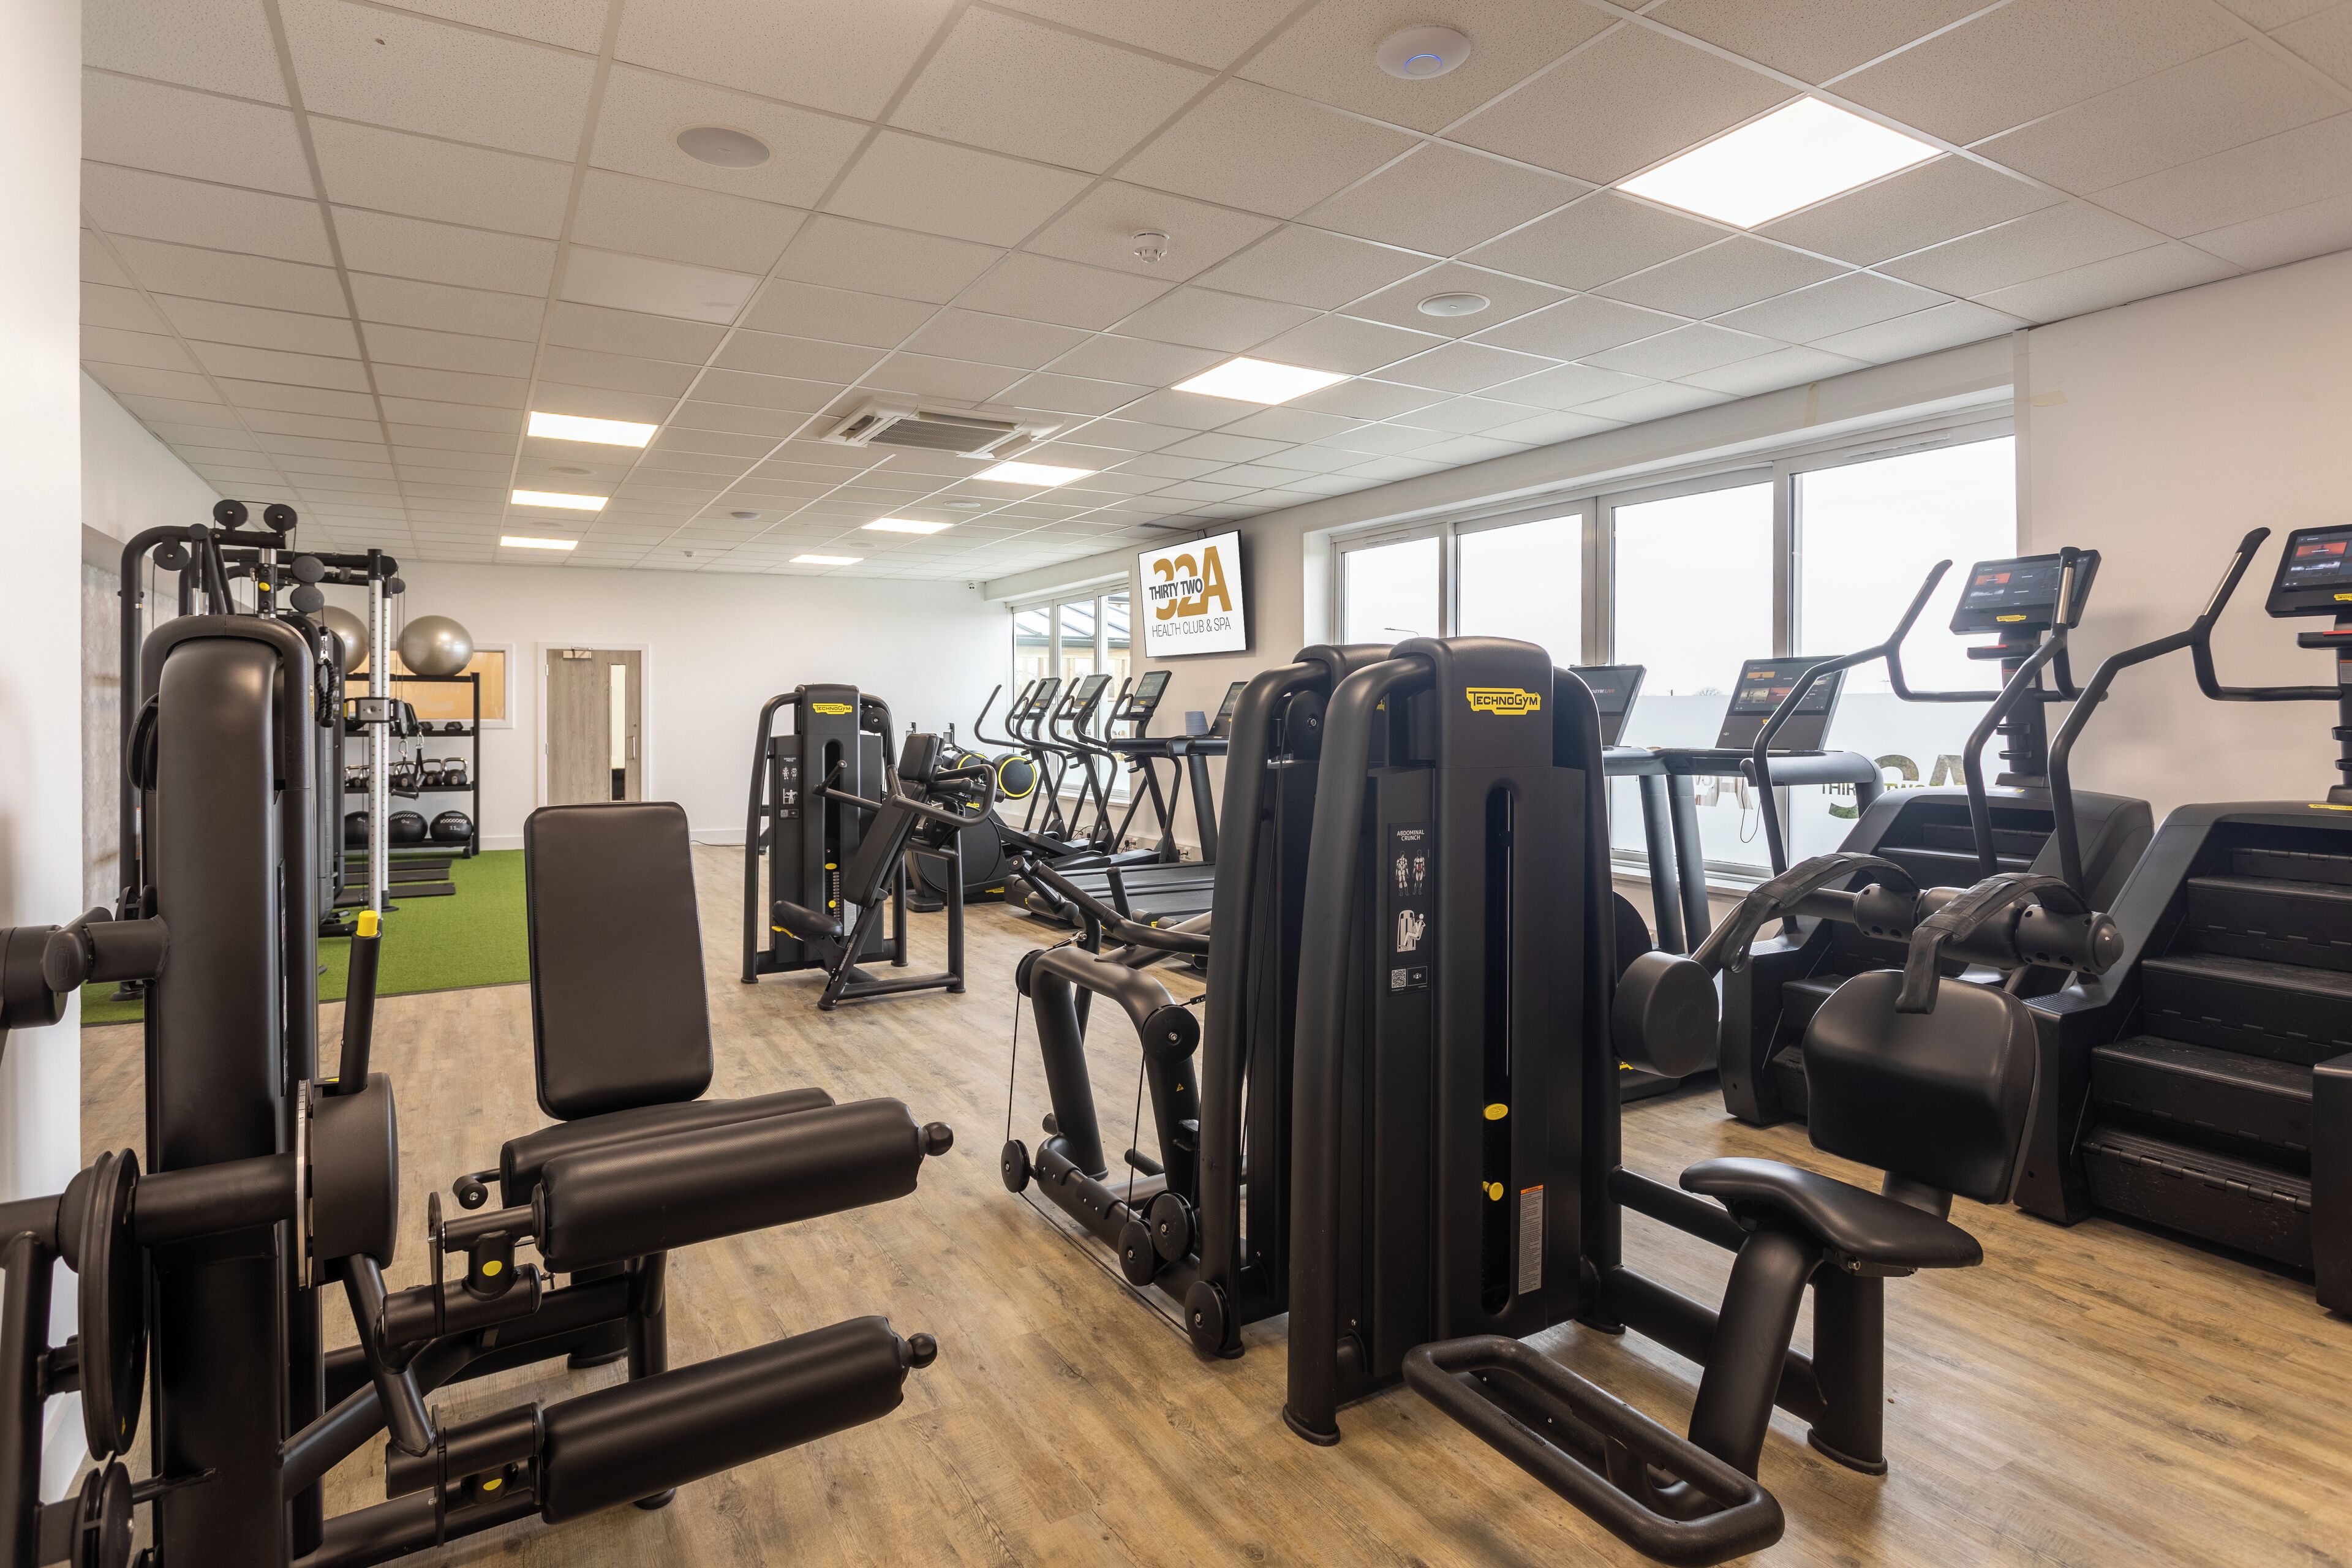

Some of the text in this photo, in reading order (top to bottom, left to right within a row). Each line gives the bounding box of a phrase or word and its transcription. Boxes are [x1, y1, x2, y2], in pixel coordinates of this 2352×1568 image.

[1149, 578, 1203, 600] THIRTY TWO
[1153, 546, 1232, 620] 32A
[1152, 616, 1231, 638] HEALTH CLUB & SPA
